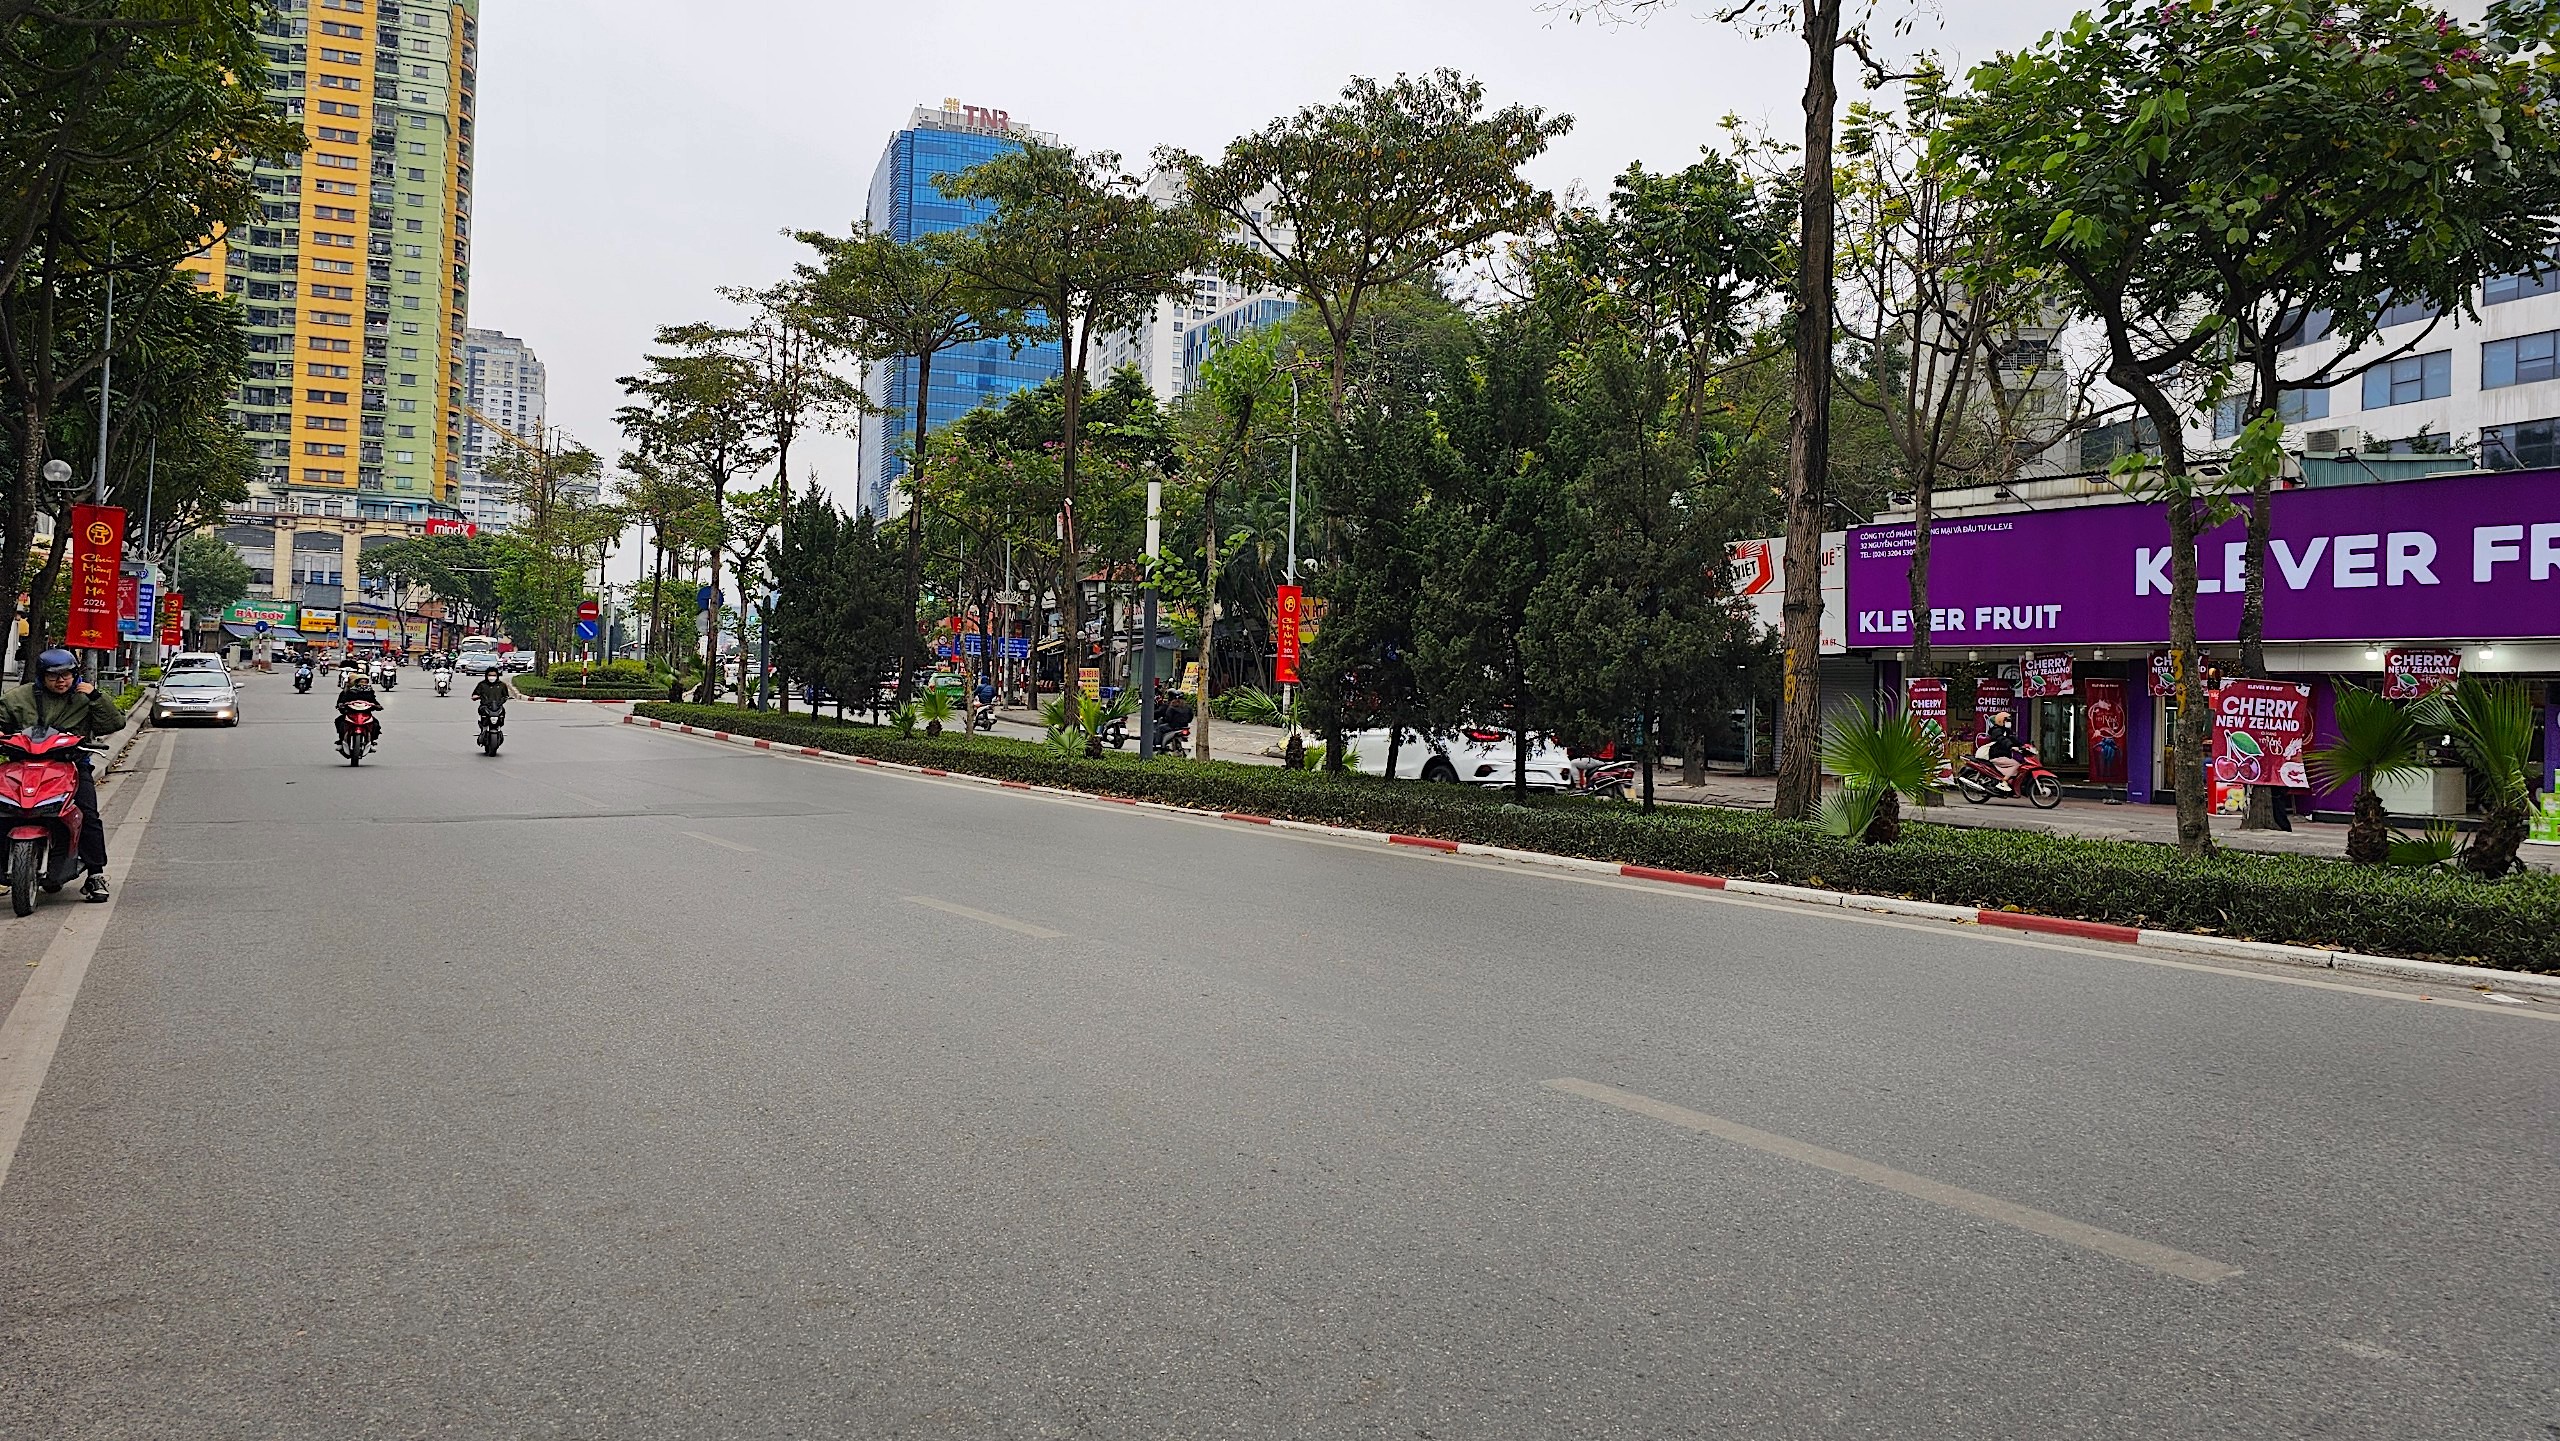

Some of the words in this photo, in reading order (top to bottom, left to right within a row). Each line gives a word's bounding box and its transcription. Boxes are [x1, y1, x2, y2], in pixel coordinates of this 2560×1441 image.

[963, 105, 1009, 130] TNR
[433, 522, 471, 537] mindX
[1860, 532, 1877, 540] CÔNG
[83, 598, 106, 607] 2024
[1975, 604, 2062, 631] FRUIT
[2026, 657, 2068, 670] CHERRY
[2390, 654, 2453, 666] CHERRY
[2025, 669, 2039, 677] NEW
[2040, 666, 2071, 675] ZEALAND
[2411, 666, 2456, 674] ZEALAND
[1911, 699, 1942, 709] CHERRY
[1977, 697, 2010, 706] CHERRY
[2222, 696, 2299, 719] CHERRY
[2215, 715, 2246, 729] NEW
[2248, 716, 2300, 732] ZEALAND
